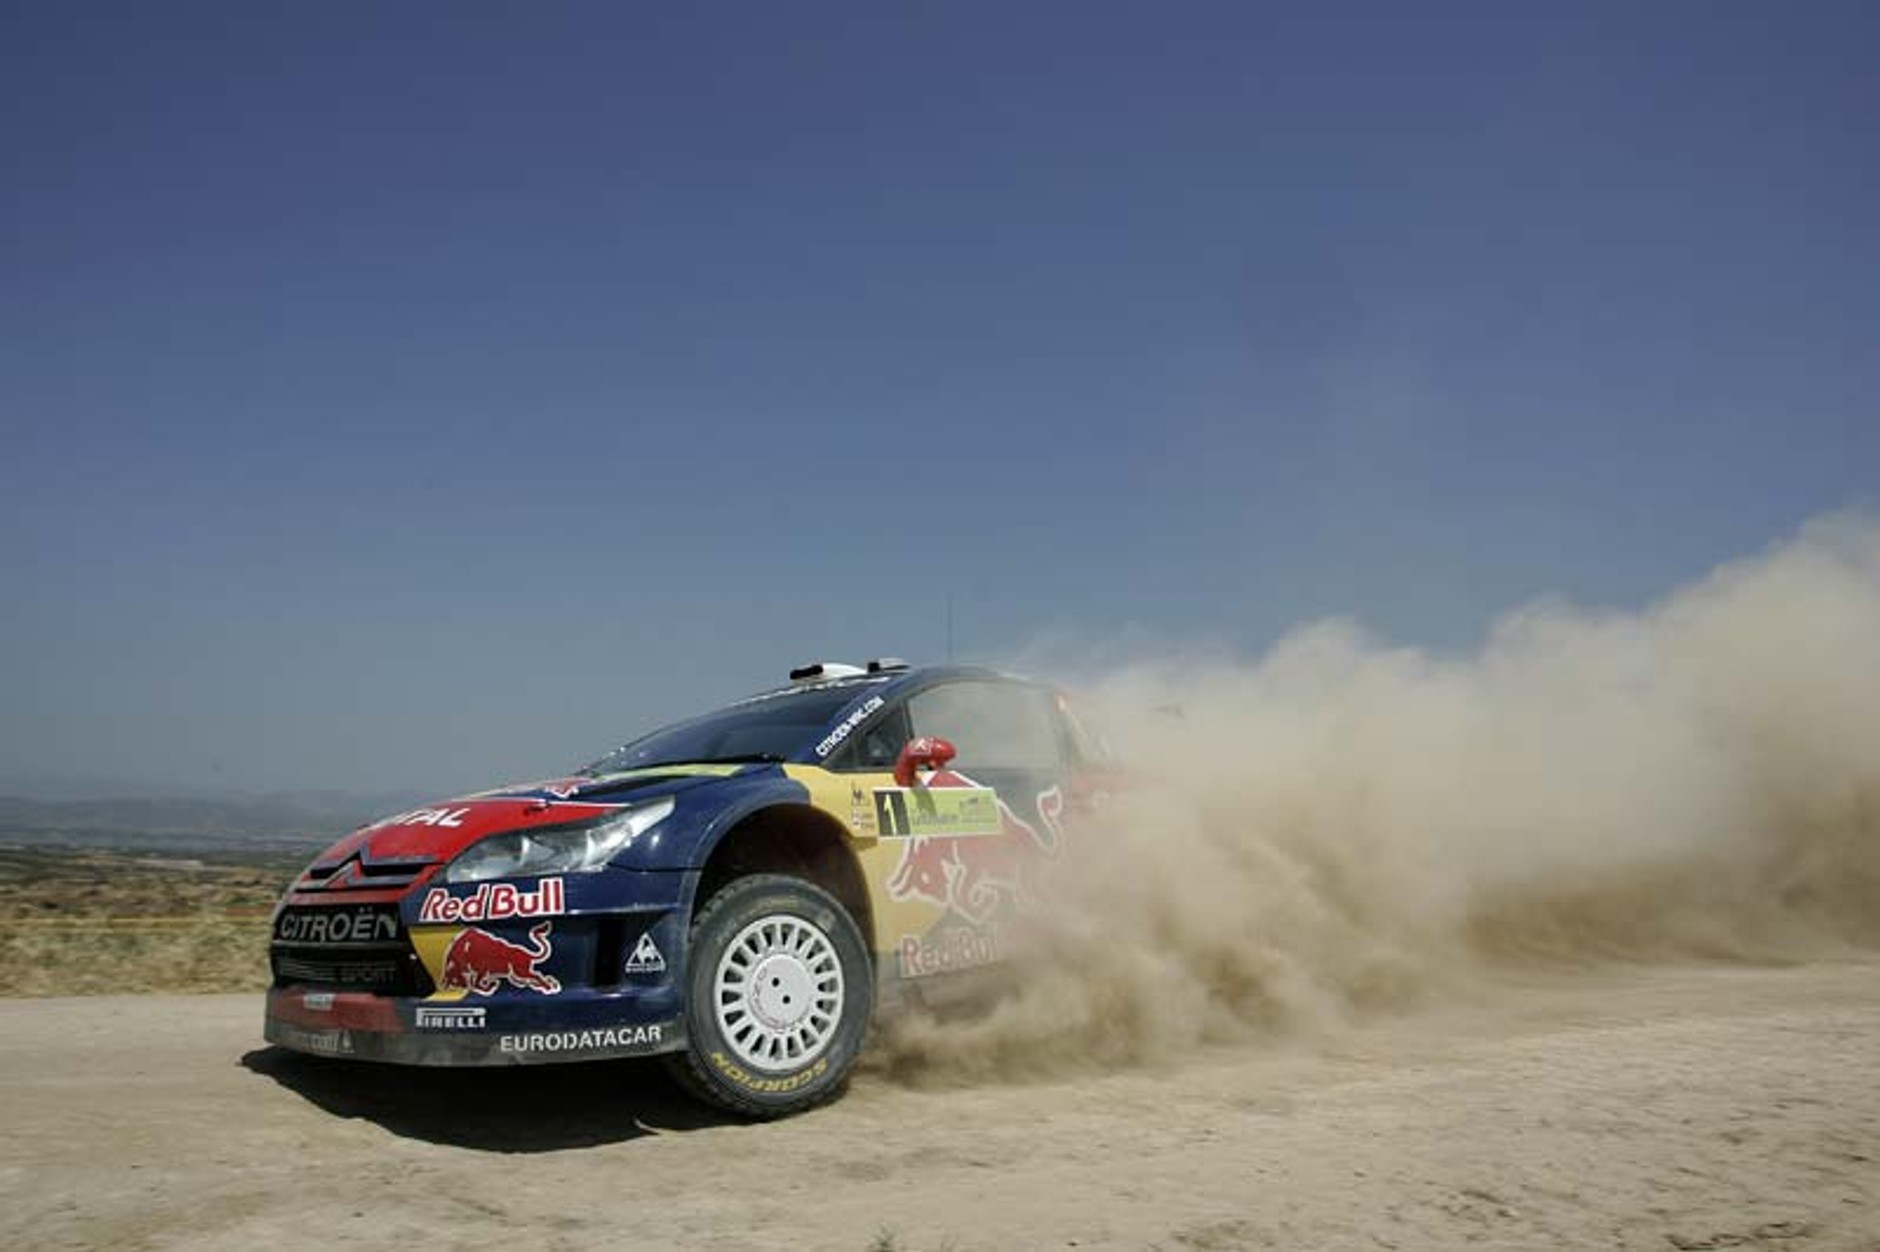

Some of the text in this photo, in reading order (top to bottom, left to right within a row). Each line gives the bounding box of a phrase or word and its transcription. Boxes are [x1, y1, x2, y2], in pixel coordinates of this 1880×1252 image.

[883, 792, 898, 836] 1
[420, 878, 565, 922] Red Bull
[279, 907, 398, 941] CITROËN
[416, 1007, 486, 1028] PIRELLI
[501, 1025, 662, 1052] EURODATACAR
